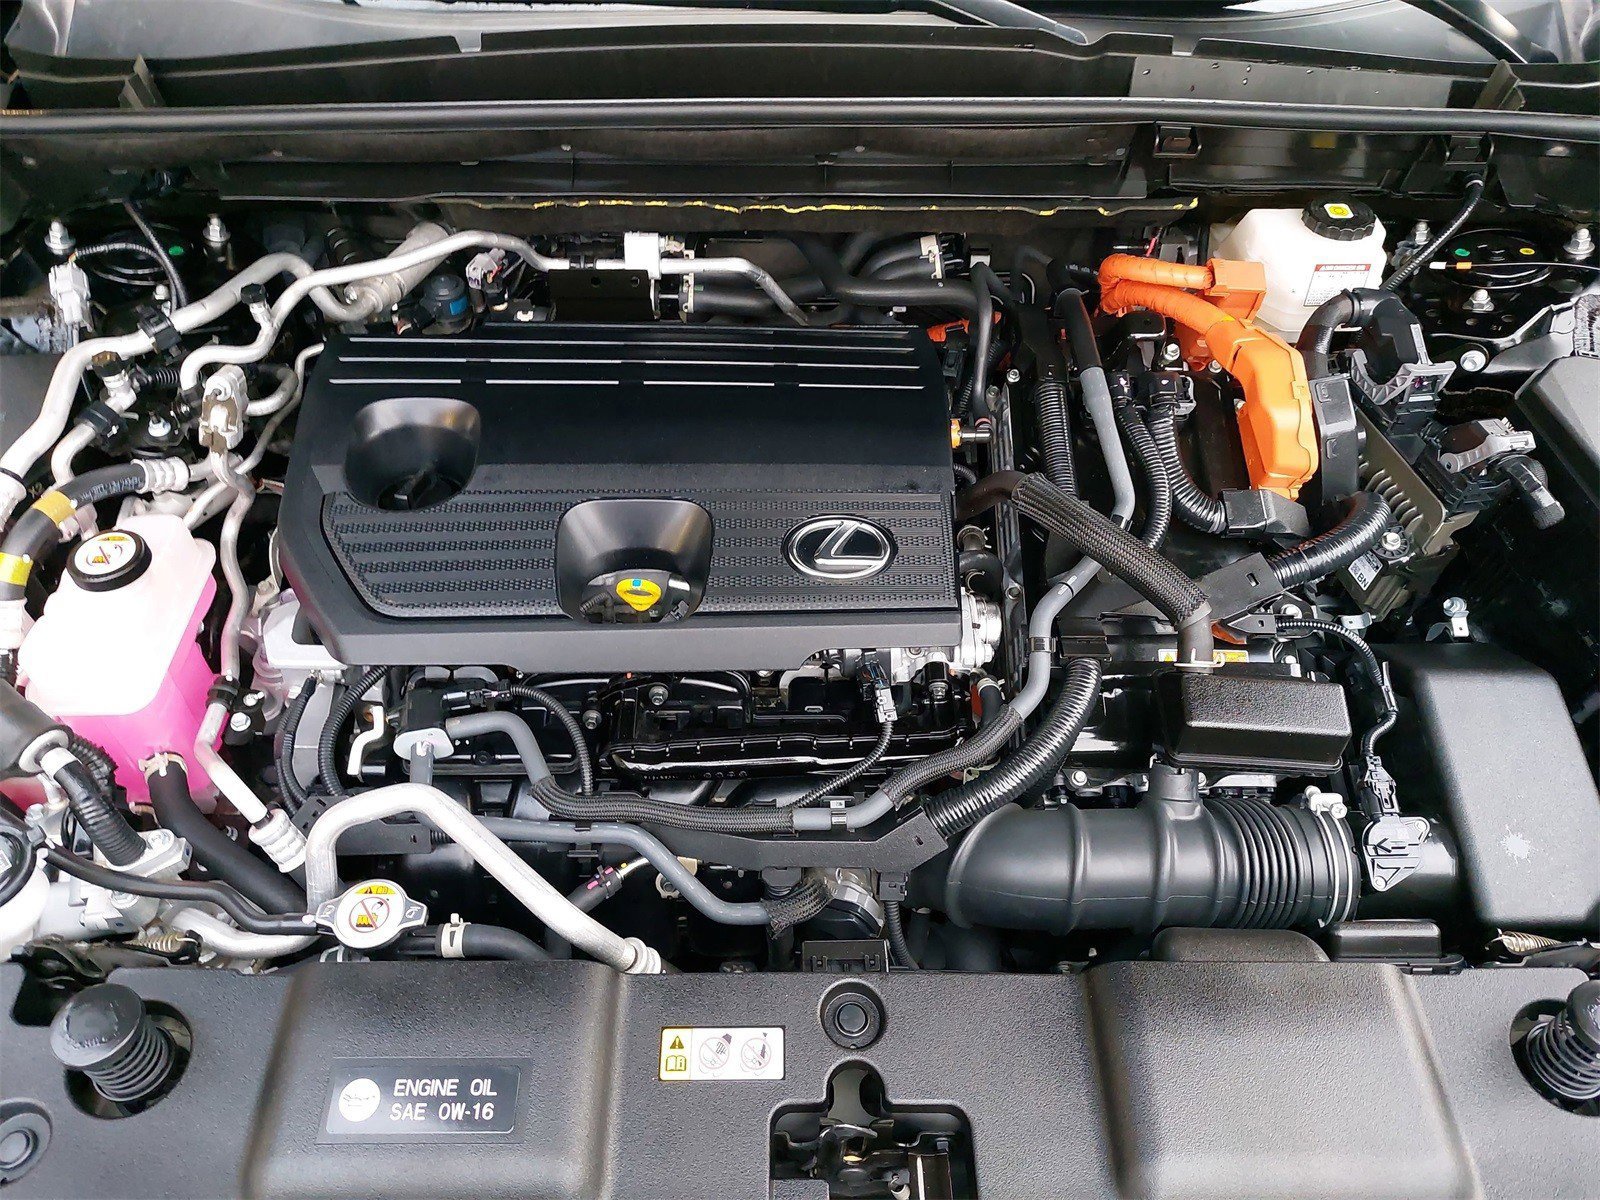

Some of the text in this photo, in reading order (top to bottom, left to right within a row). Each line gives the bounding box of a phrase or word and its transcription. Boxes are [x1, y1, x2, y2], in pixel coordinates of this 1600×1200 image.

[393, 1078, 498, 1097] ENGINE OIL
[389, 1102, 495, 1121] SAE 0W-16
